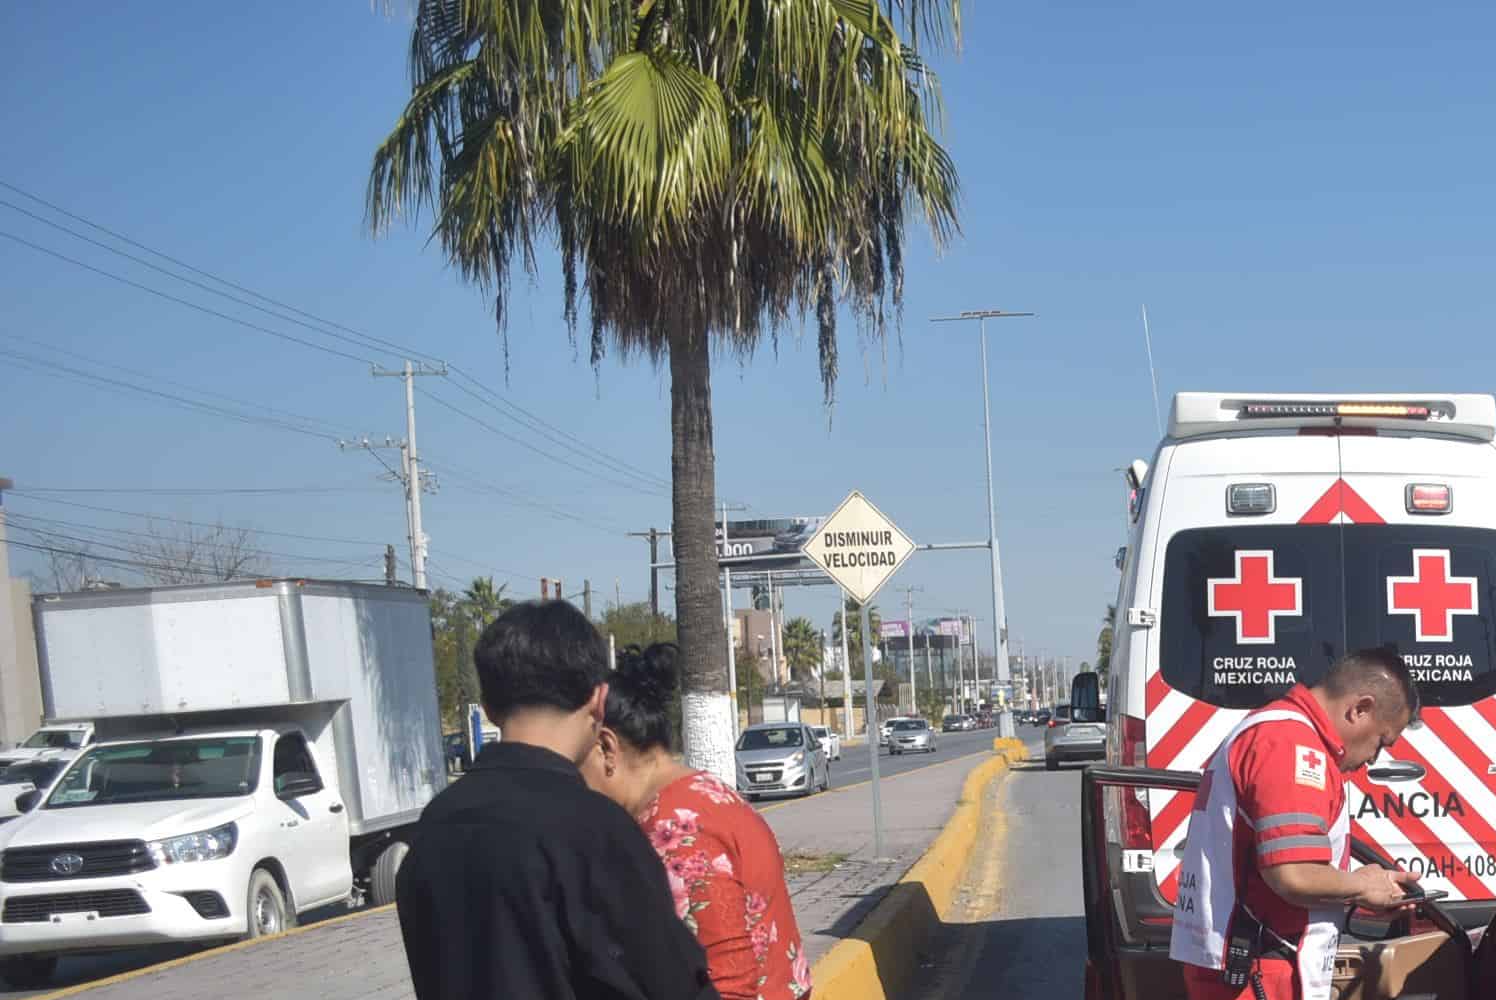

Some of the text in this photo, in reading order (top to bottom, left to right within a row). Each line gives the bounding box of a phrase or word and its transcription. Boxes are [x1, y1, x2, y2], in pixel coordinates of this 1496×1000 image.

[824, 531, 893, 547] DISMINUIR
[824, 551, 896, 568] VELOCIDAD
[1213, 656, 1296, 670] CRUZ ROJA
[1402, 655, 1473, 667] RUZ ROJA
[1214, 671, 1296, 685] MEXICANA
[1409, 669, 1473, 682] EXICANA
[1350, 792, 1464, 819] ANCIA
